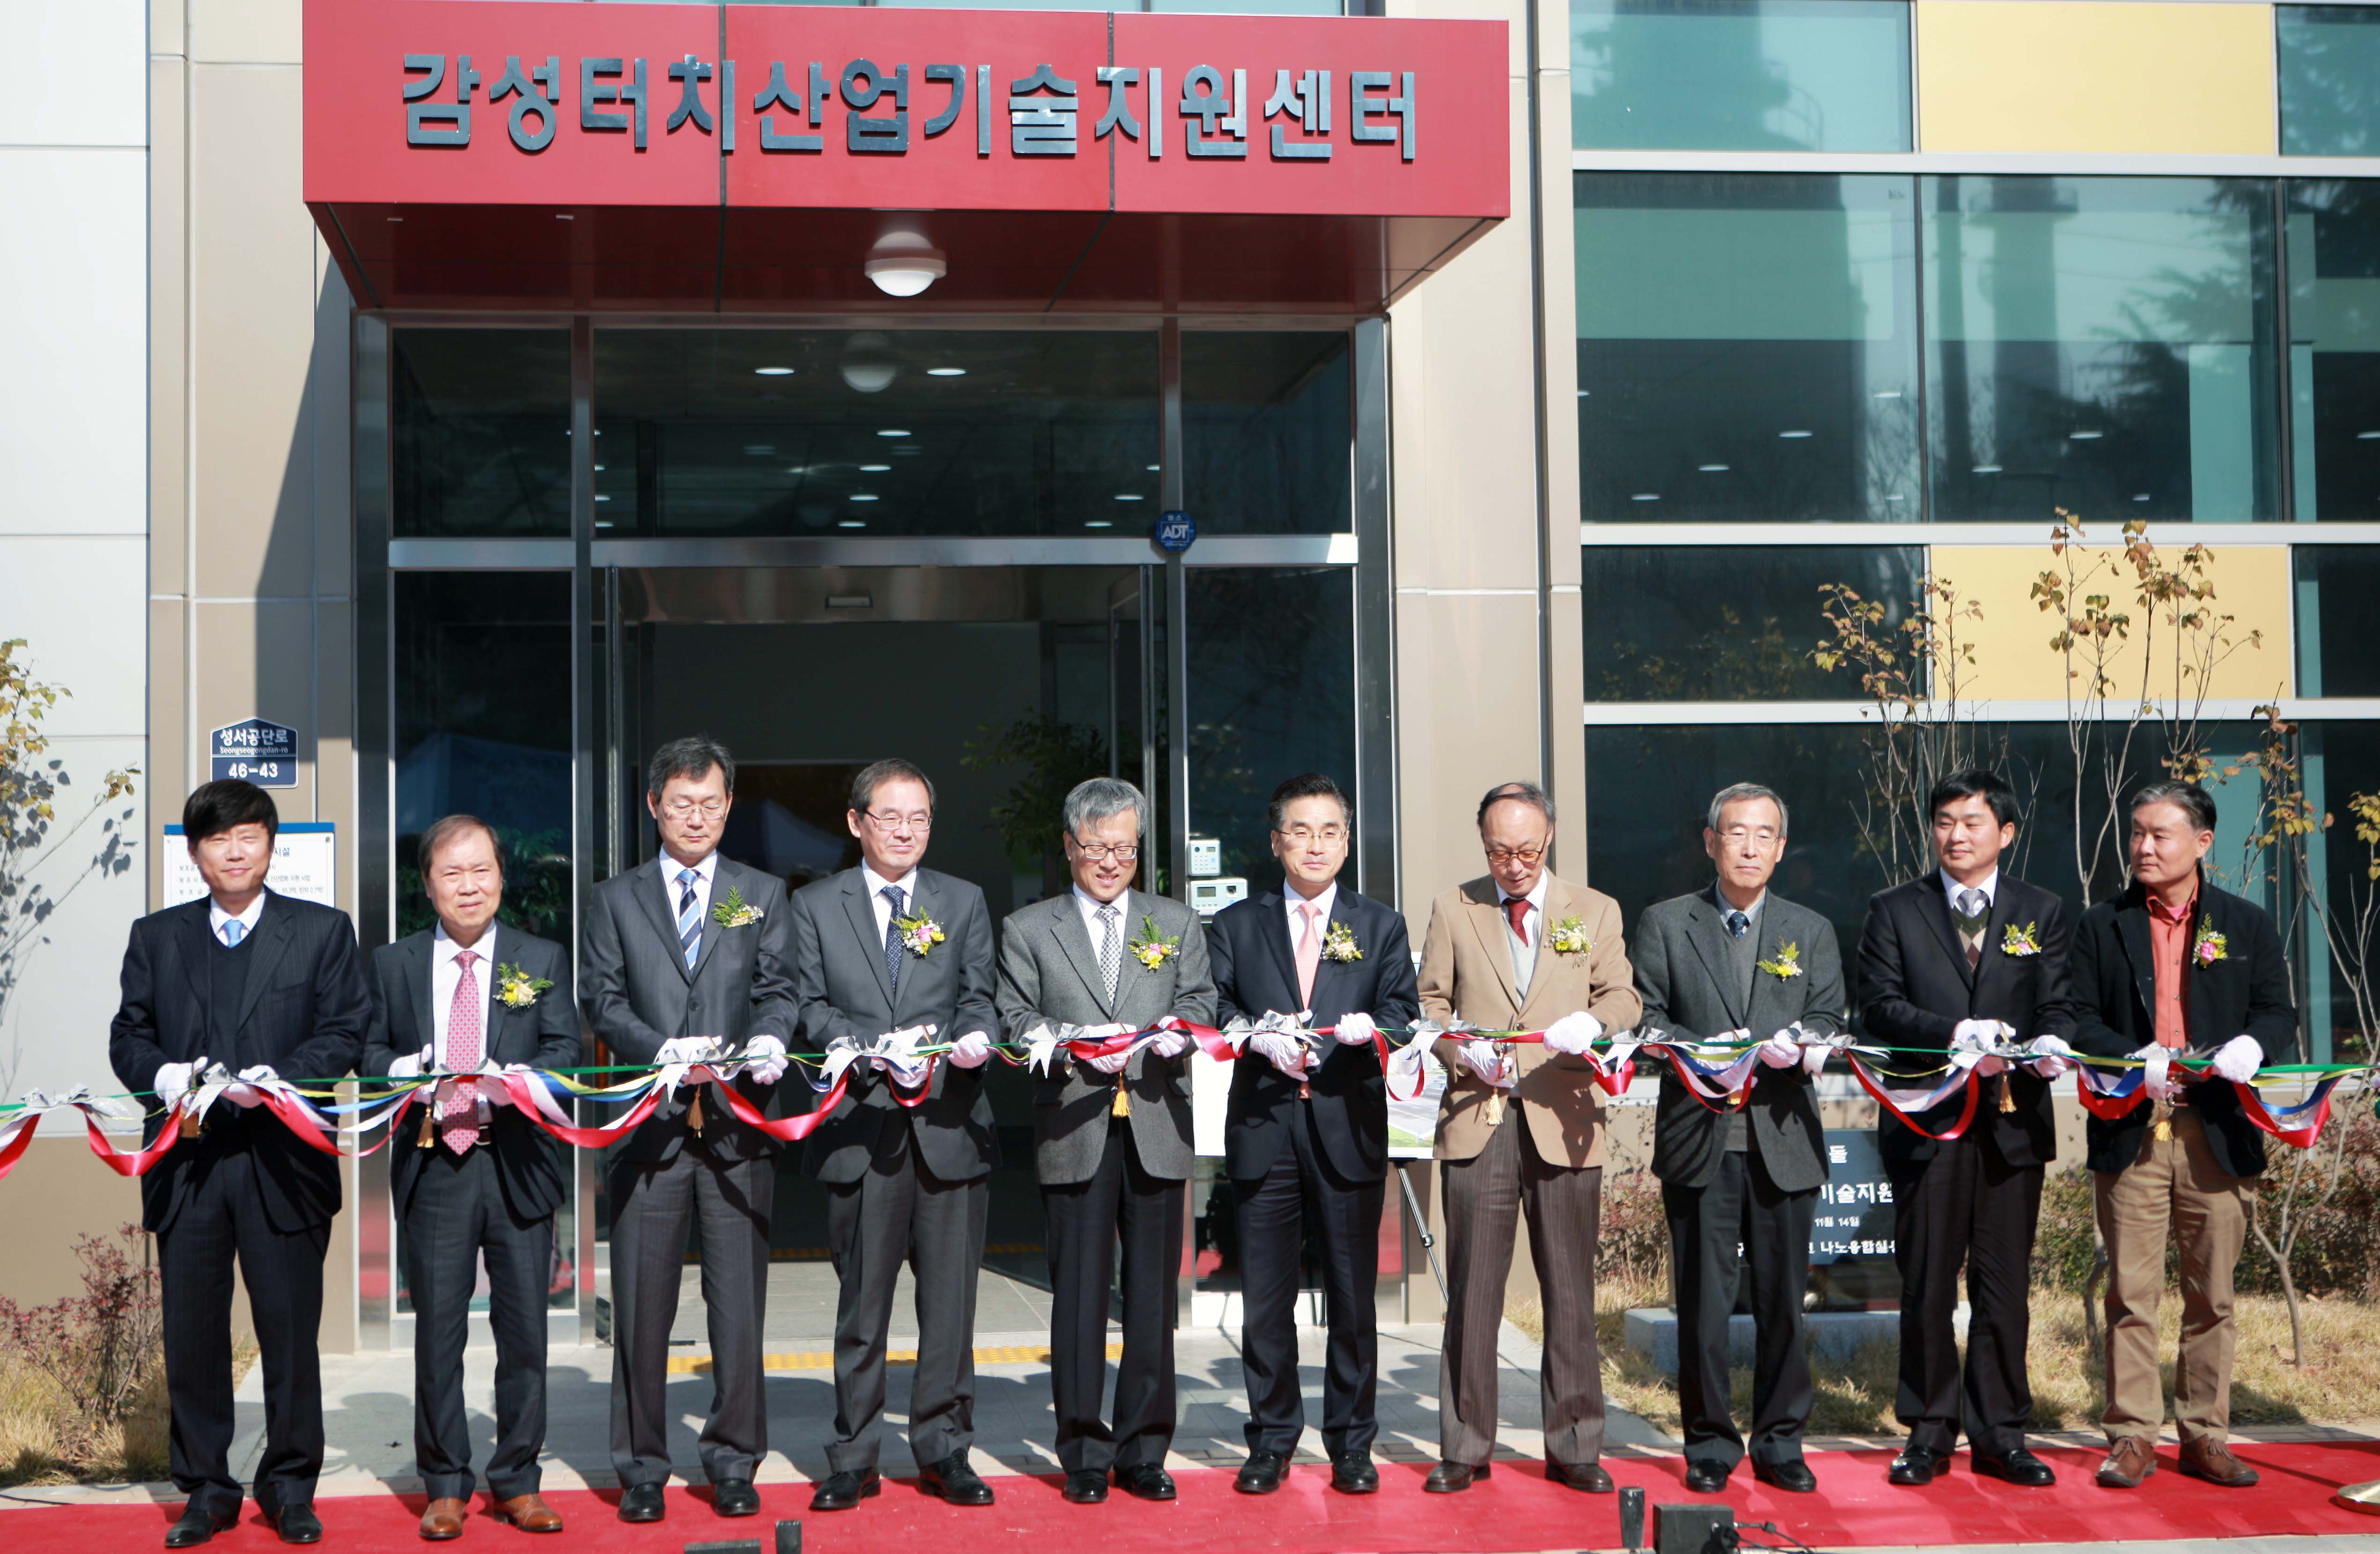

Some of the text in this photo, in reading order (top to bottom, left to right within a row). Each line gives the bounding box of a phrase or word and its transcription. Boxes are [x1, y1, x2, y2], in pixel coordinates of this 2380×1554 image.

[403, 54, 1415, 159] 감성터치산업기술지원센터
[1161, 525, 1188, 539] ADT
[220, 728, 288, 746] 성서공단로
[220, 746, 288, 755] Seongseogongdan-ro
[228, 762, 278, 778] 46-43
[1838, 1217, 1860, 1227] 14일
